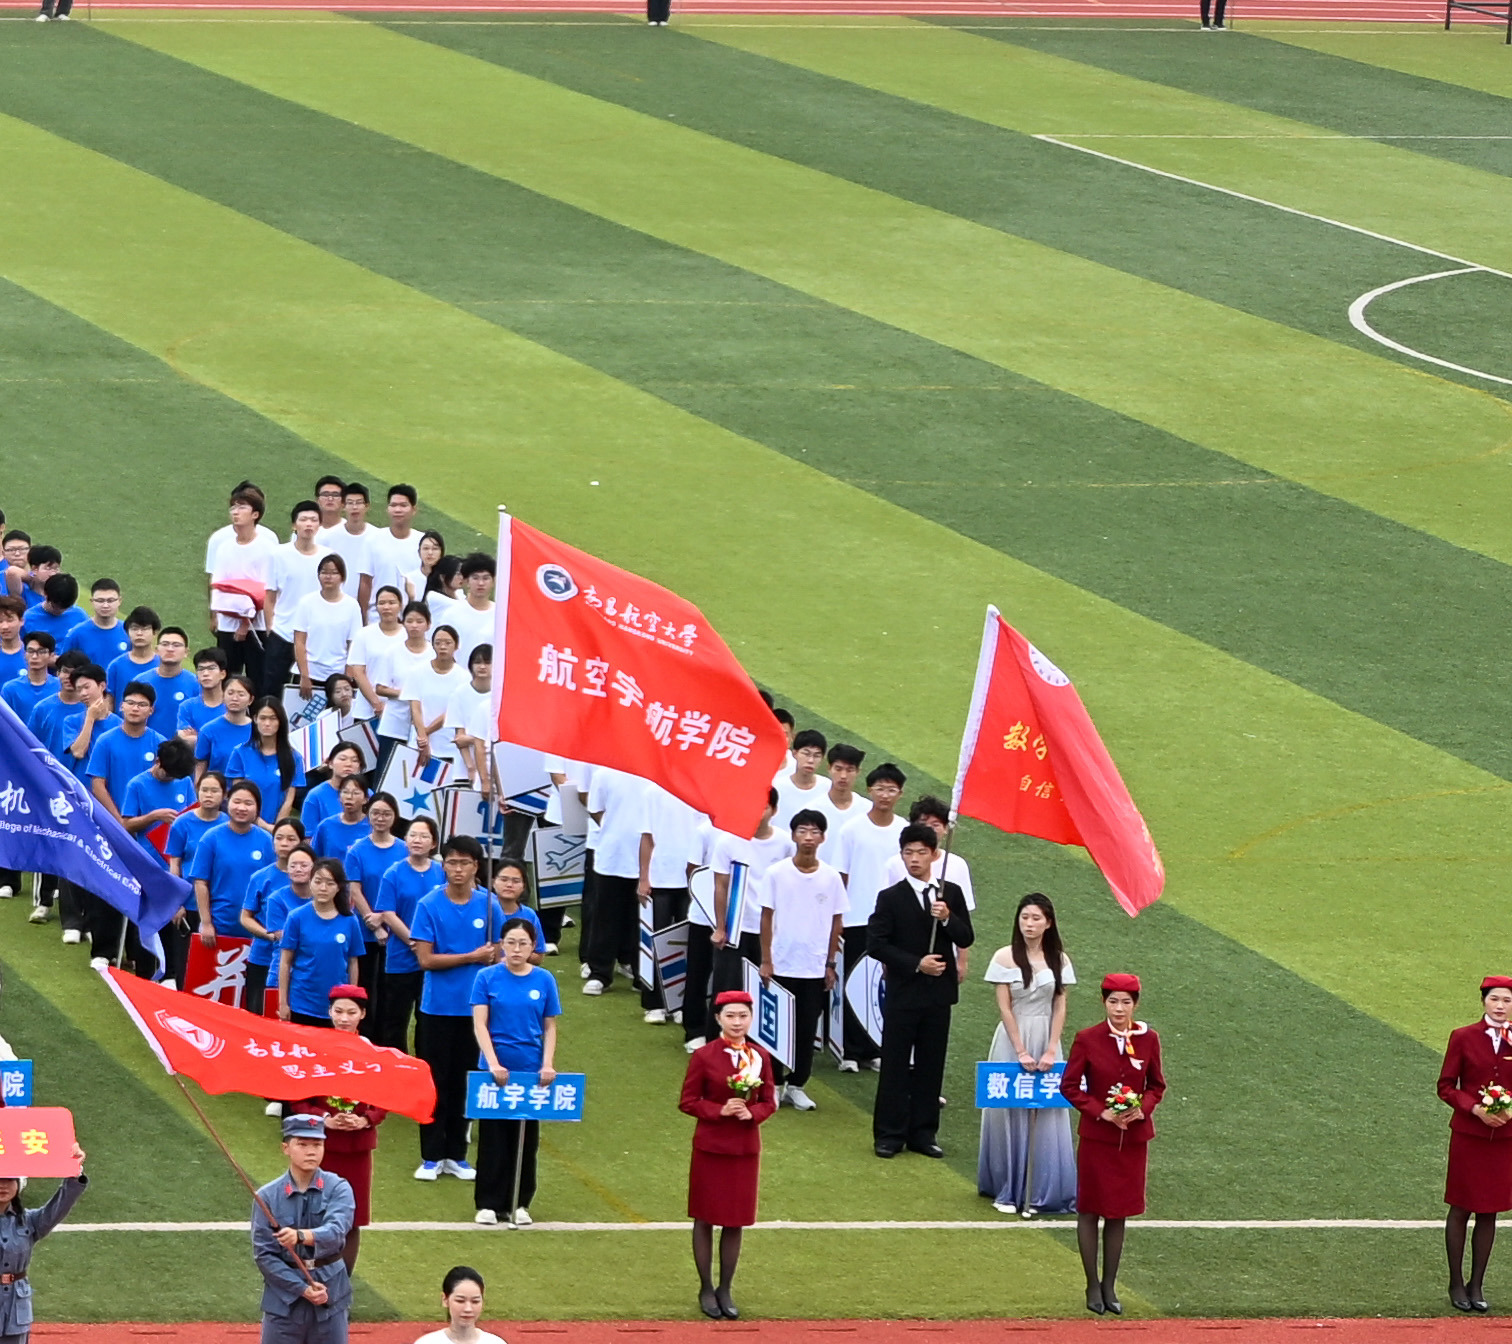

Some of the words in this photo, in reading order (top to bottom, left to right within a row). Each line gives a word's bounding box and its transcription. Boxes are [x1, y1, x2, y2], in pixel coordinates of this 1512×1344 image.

[537, 643, 757, 767] 航空宇航学院
[476, 1083, 577, 1111] 航宇学院
